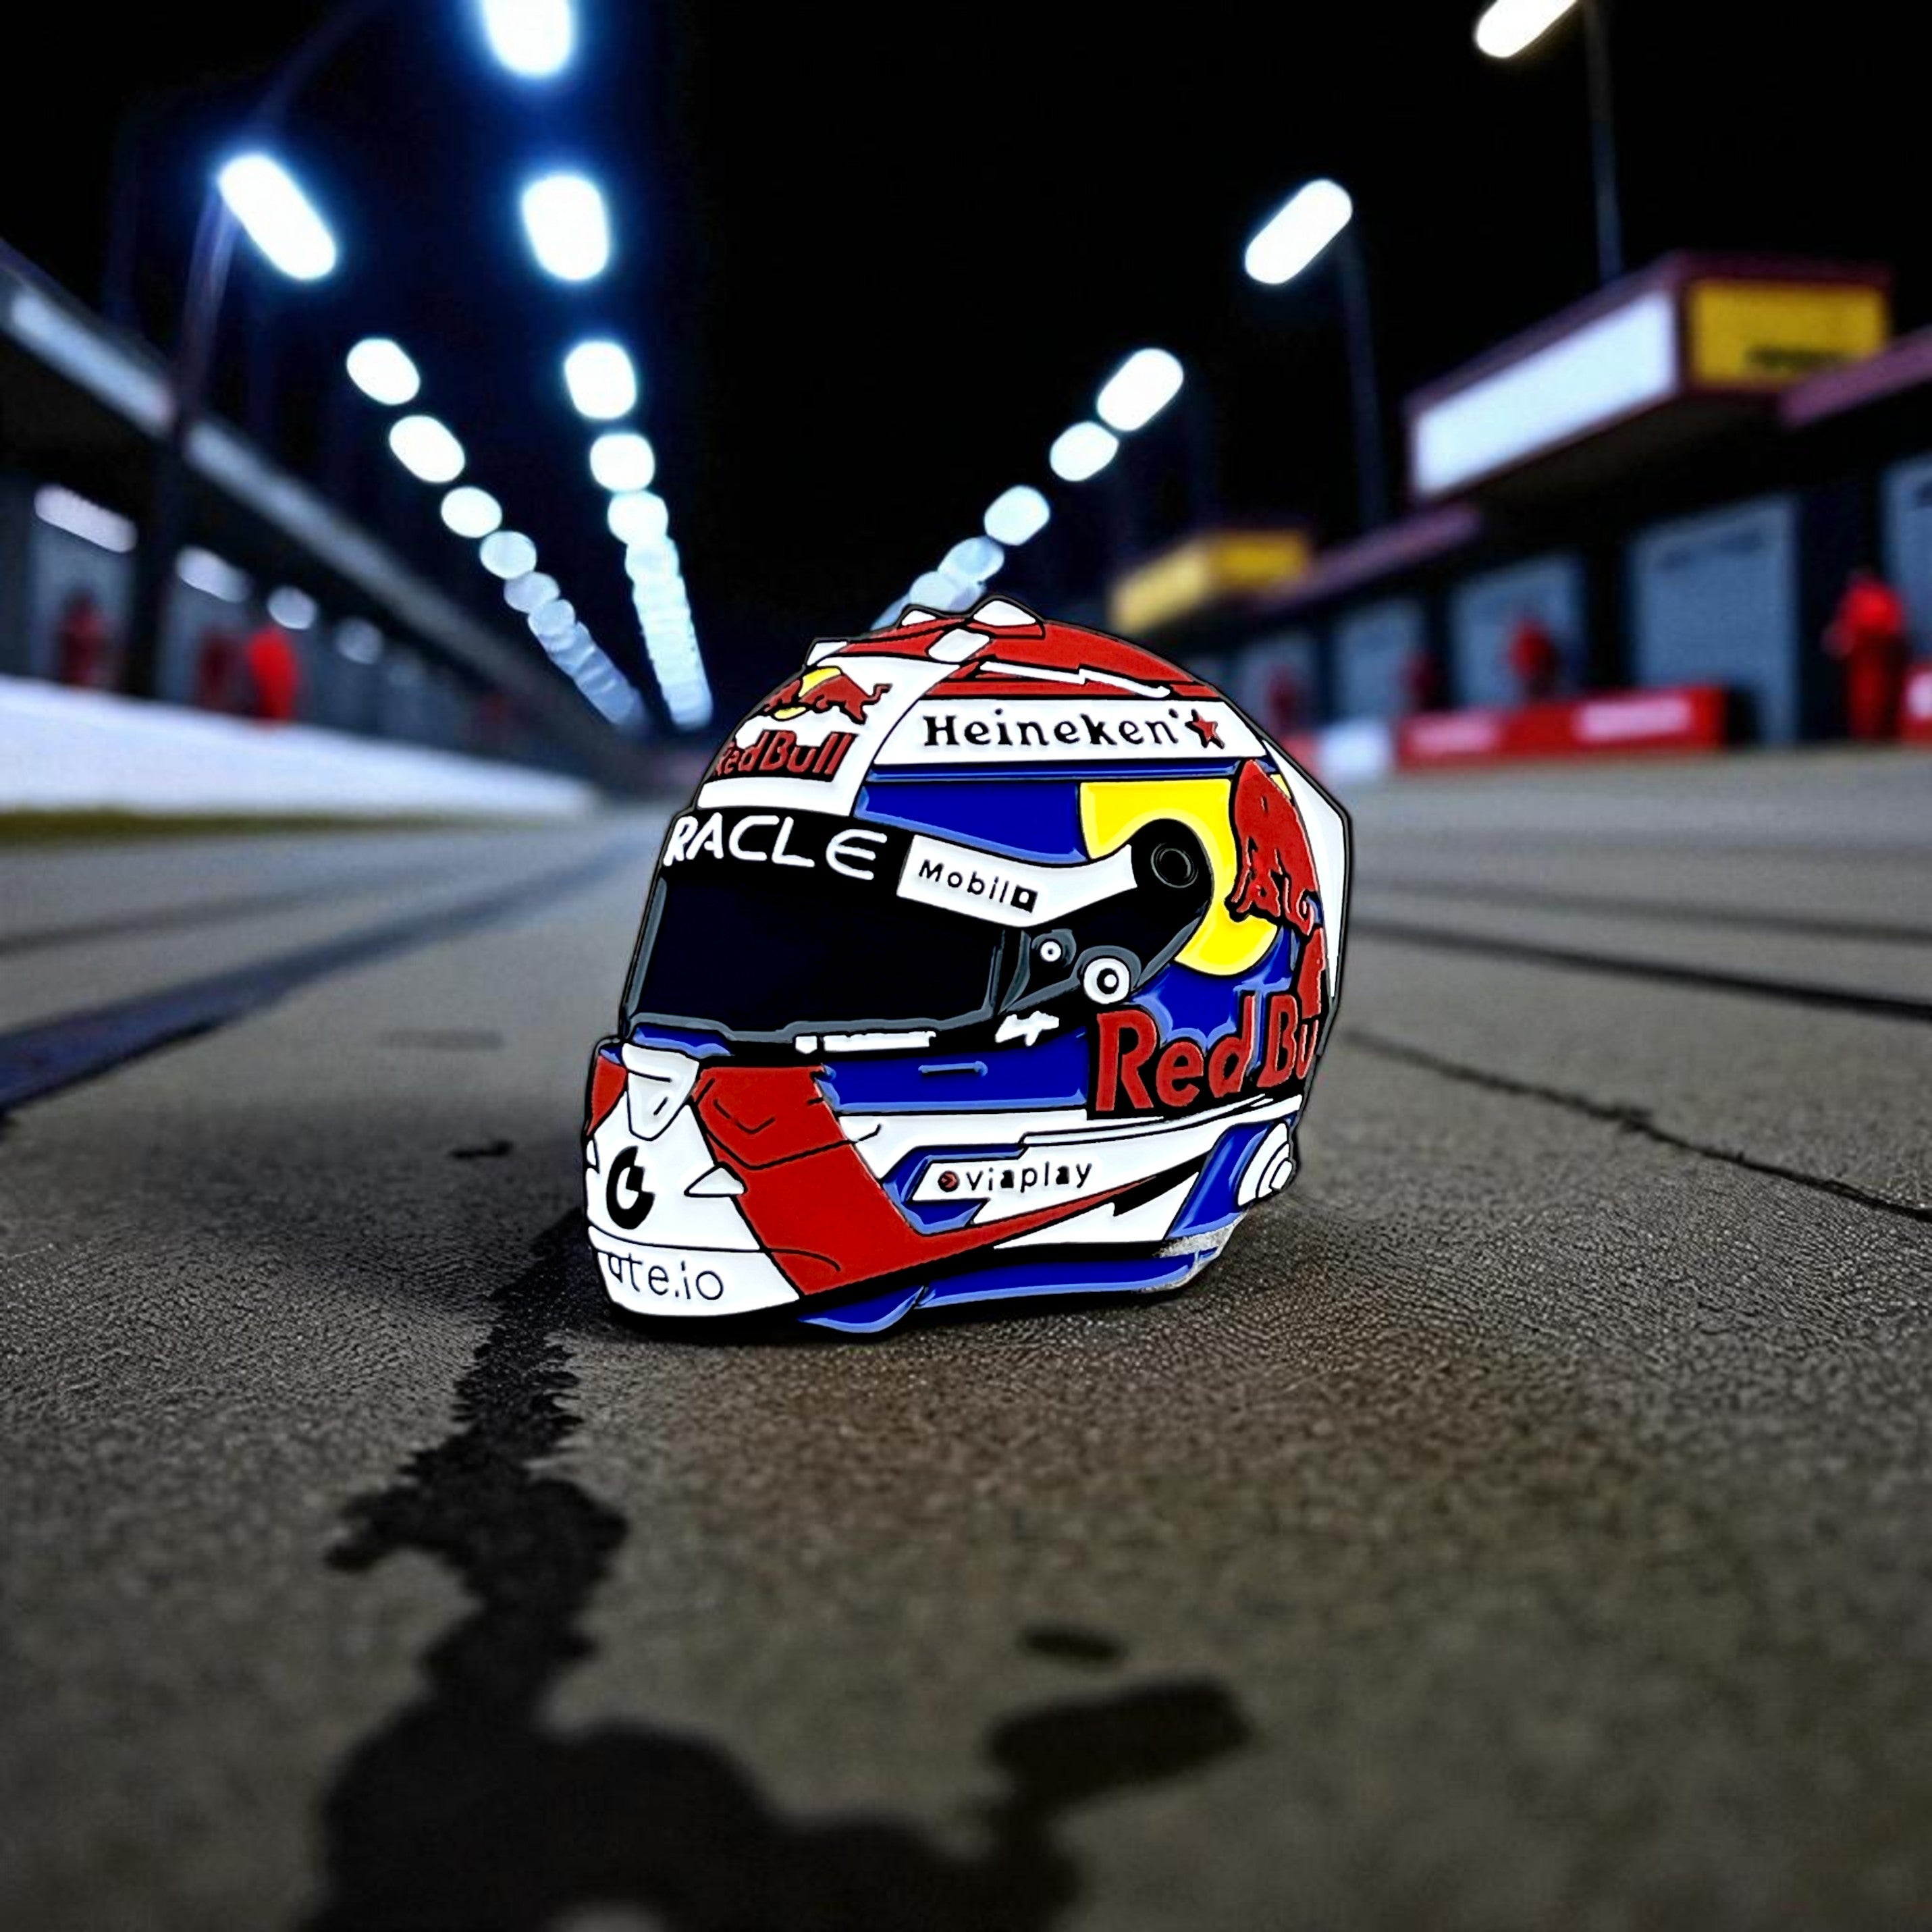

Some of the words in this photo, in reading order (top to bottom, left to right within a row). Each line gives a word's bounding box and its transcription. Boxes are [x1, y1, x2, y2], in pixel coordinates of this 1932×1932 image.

[664, 812, 888, 881] RACLE
[919, 859, 1009, 903] Mobil
[1096, 996, 1256, 1112] Red
[966, 1161, 1092, 1193] viaplay
